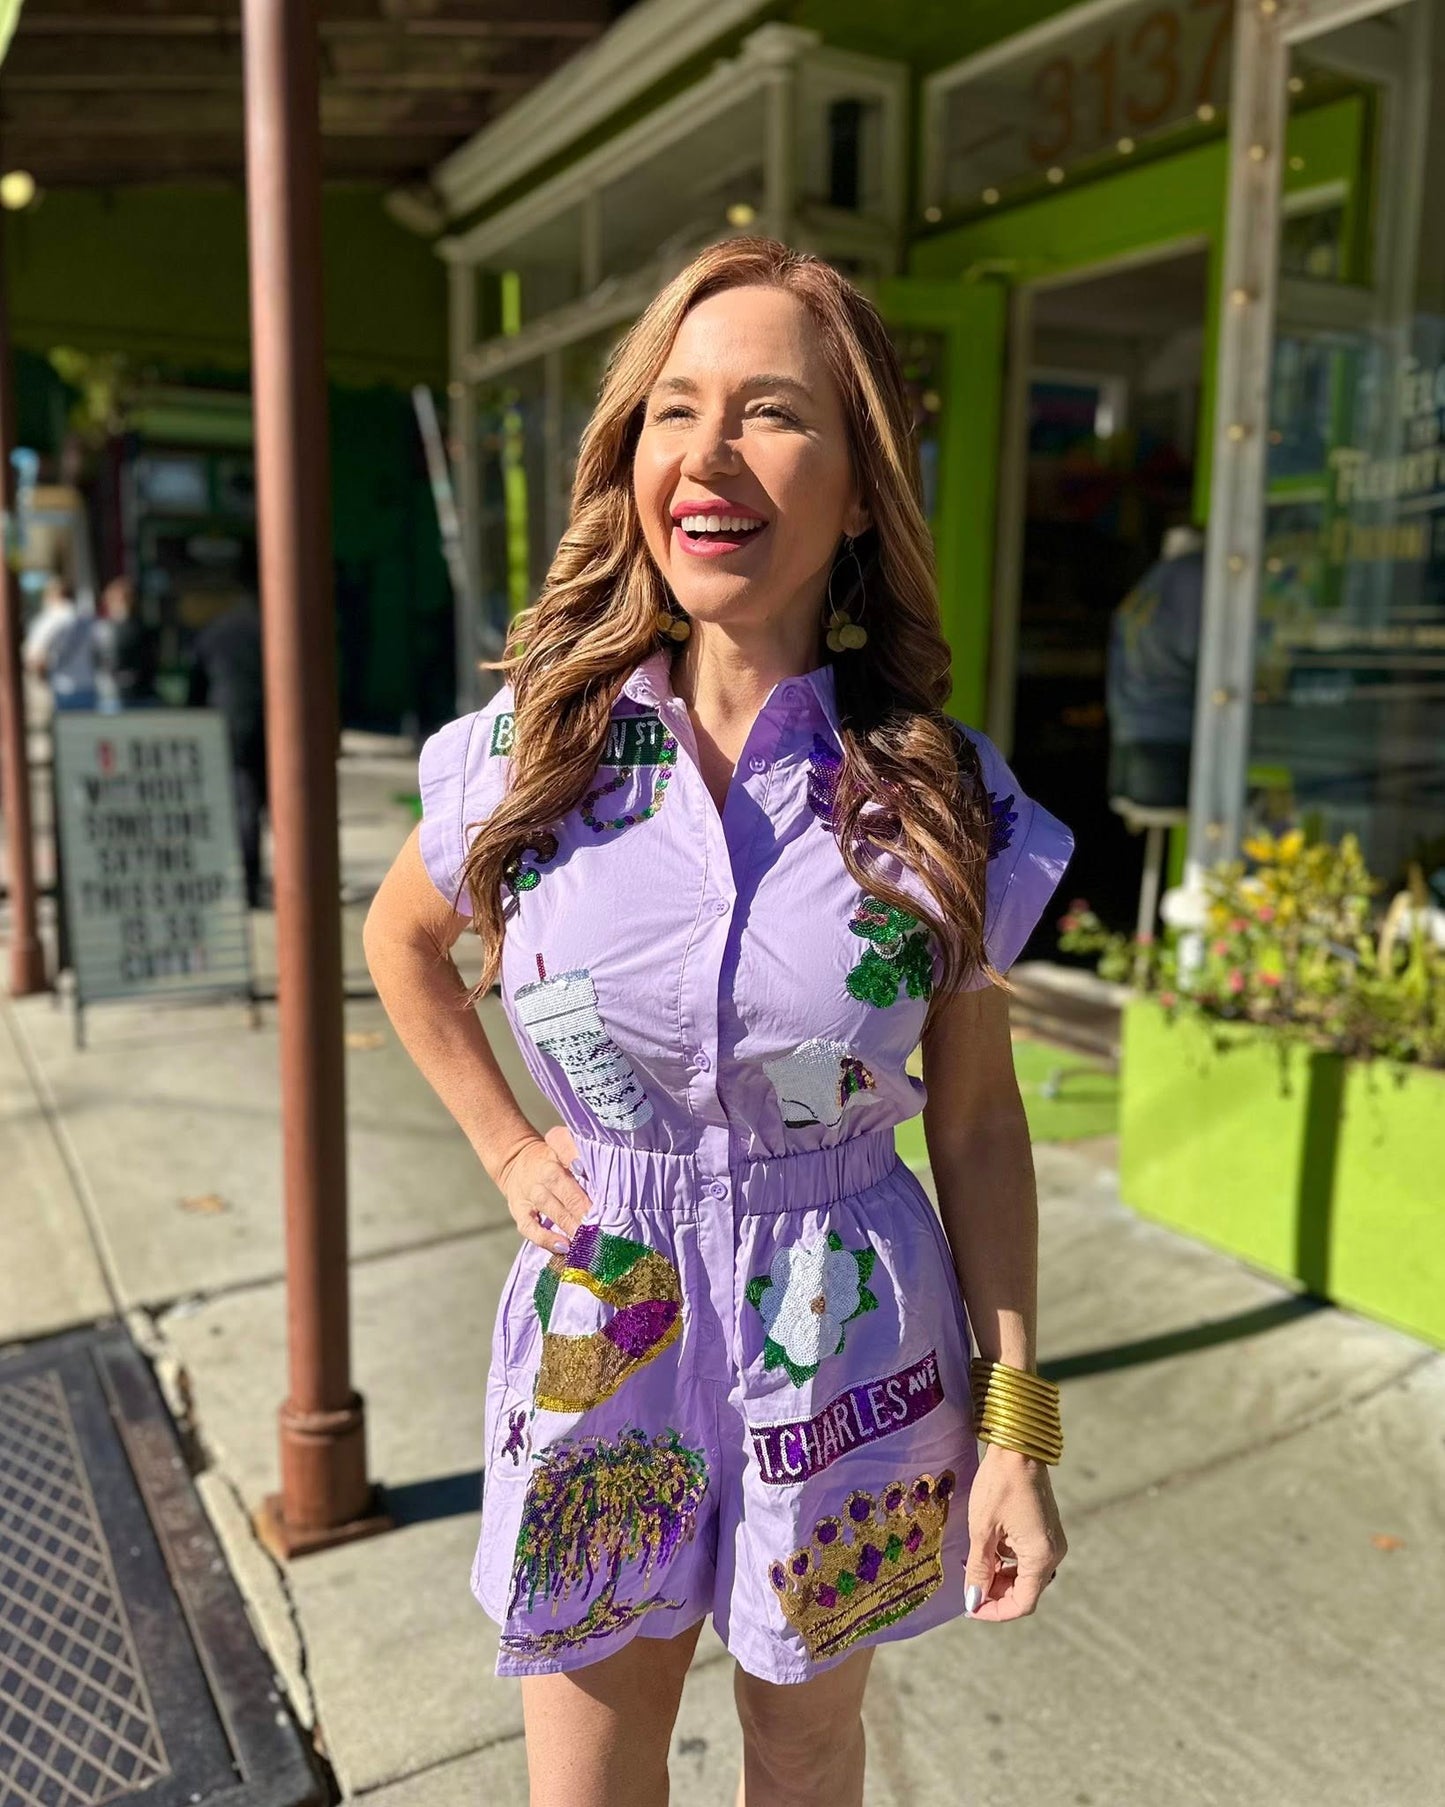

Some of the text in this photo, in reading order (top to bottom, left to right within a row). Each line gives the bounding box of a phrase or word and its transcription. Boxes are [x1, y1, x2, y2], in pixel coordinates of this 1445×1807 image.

[635, 720, 660, 747] ST
[130, 738, 200, 771] DAYS
[908, 1361, 937, 1395] AVE
